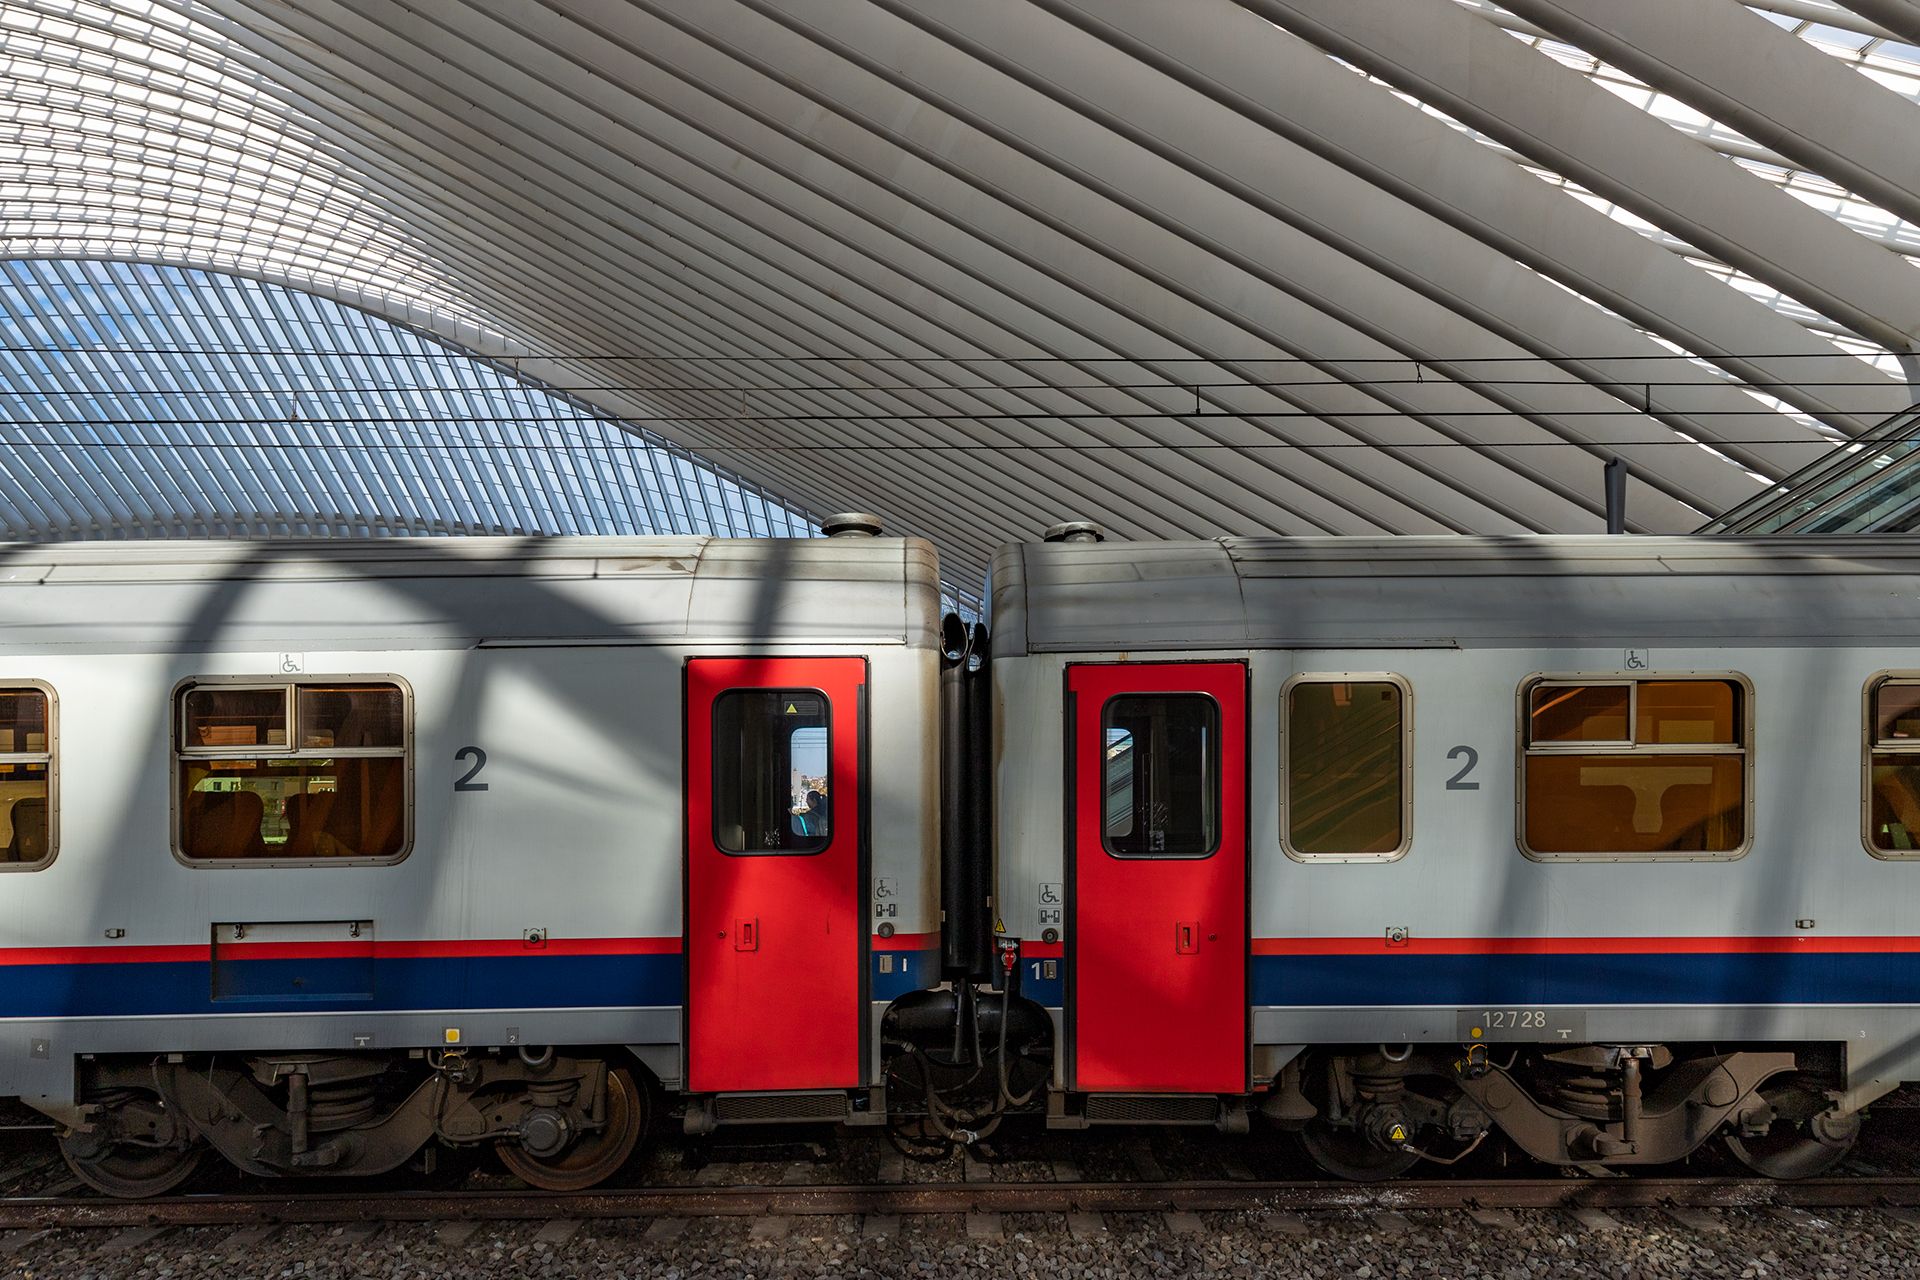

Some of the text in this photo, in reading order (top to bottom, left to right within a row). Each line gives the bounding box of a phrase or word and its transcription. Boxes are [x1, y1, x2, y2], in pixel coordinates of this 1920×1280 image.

[454, 745, 488, 791] 2
[1446, 745, 1480, 790] 2
[1031, 962, 1040, 980] 1
[1482, 1010, 1546, 1029] 12728
[509, 1035, 516, 1044] 2
